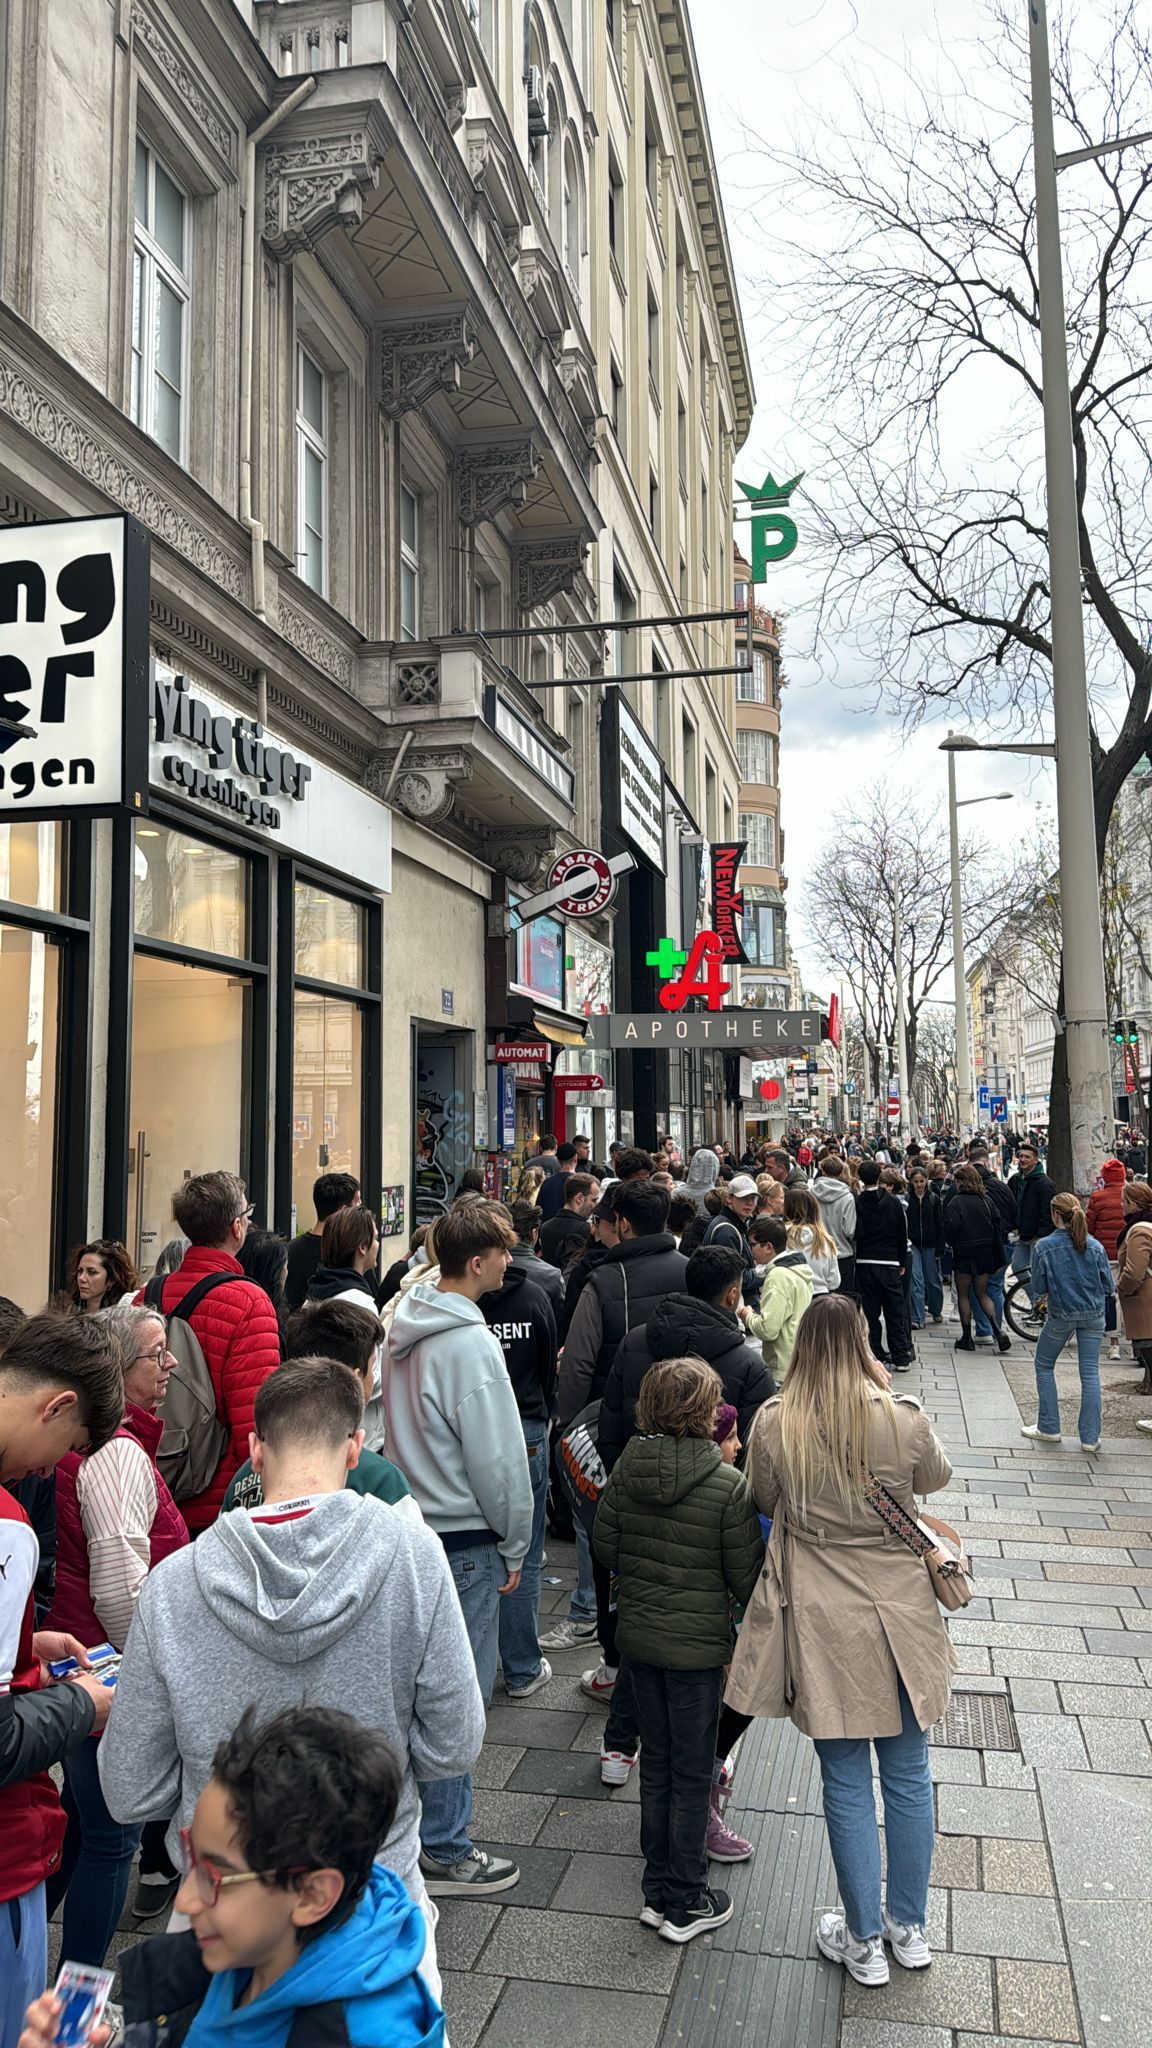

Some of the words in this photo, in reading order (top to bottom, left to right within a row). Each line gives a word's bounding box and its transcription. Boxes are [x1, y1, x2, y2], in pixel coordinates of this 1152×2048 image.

[751, 514, 799, 584] P
[232, 717, 311, 801] tiger
[0, 758, 95, 799] gen
[163, 755, 280, 829] copenhagen
[552, 853, 598, 883] TABAK
[567, 876, 610, 912] TRAFIK
[624, 1018, 812, 1039] APOTHEKE
[497, 1047, 545, 1058] AUTOMAT
